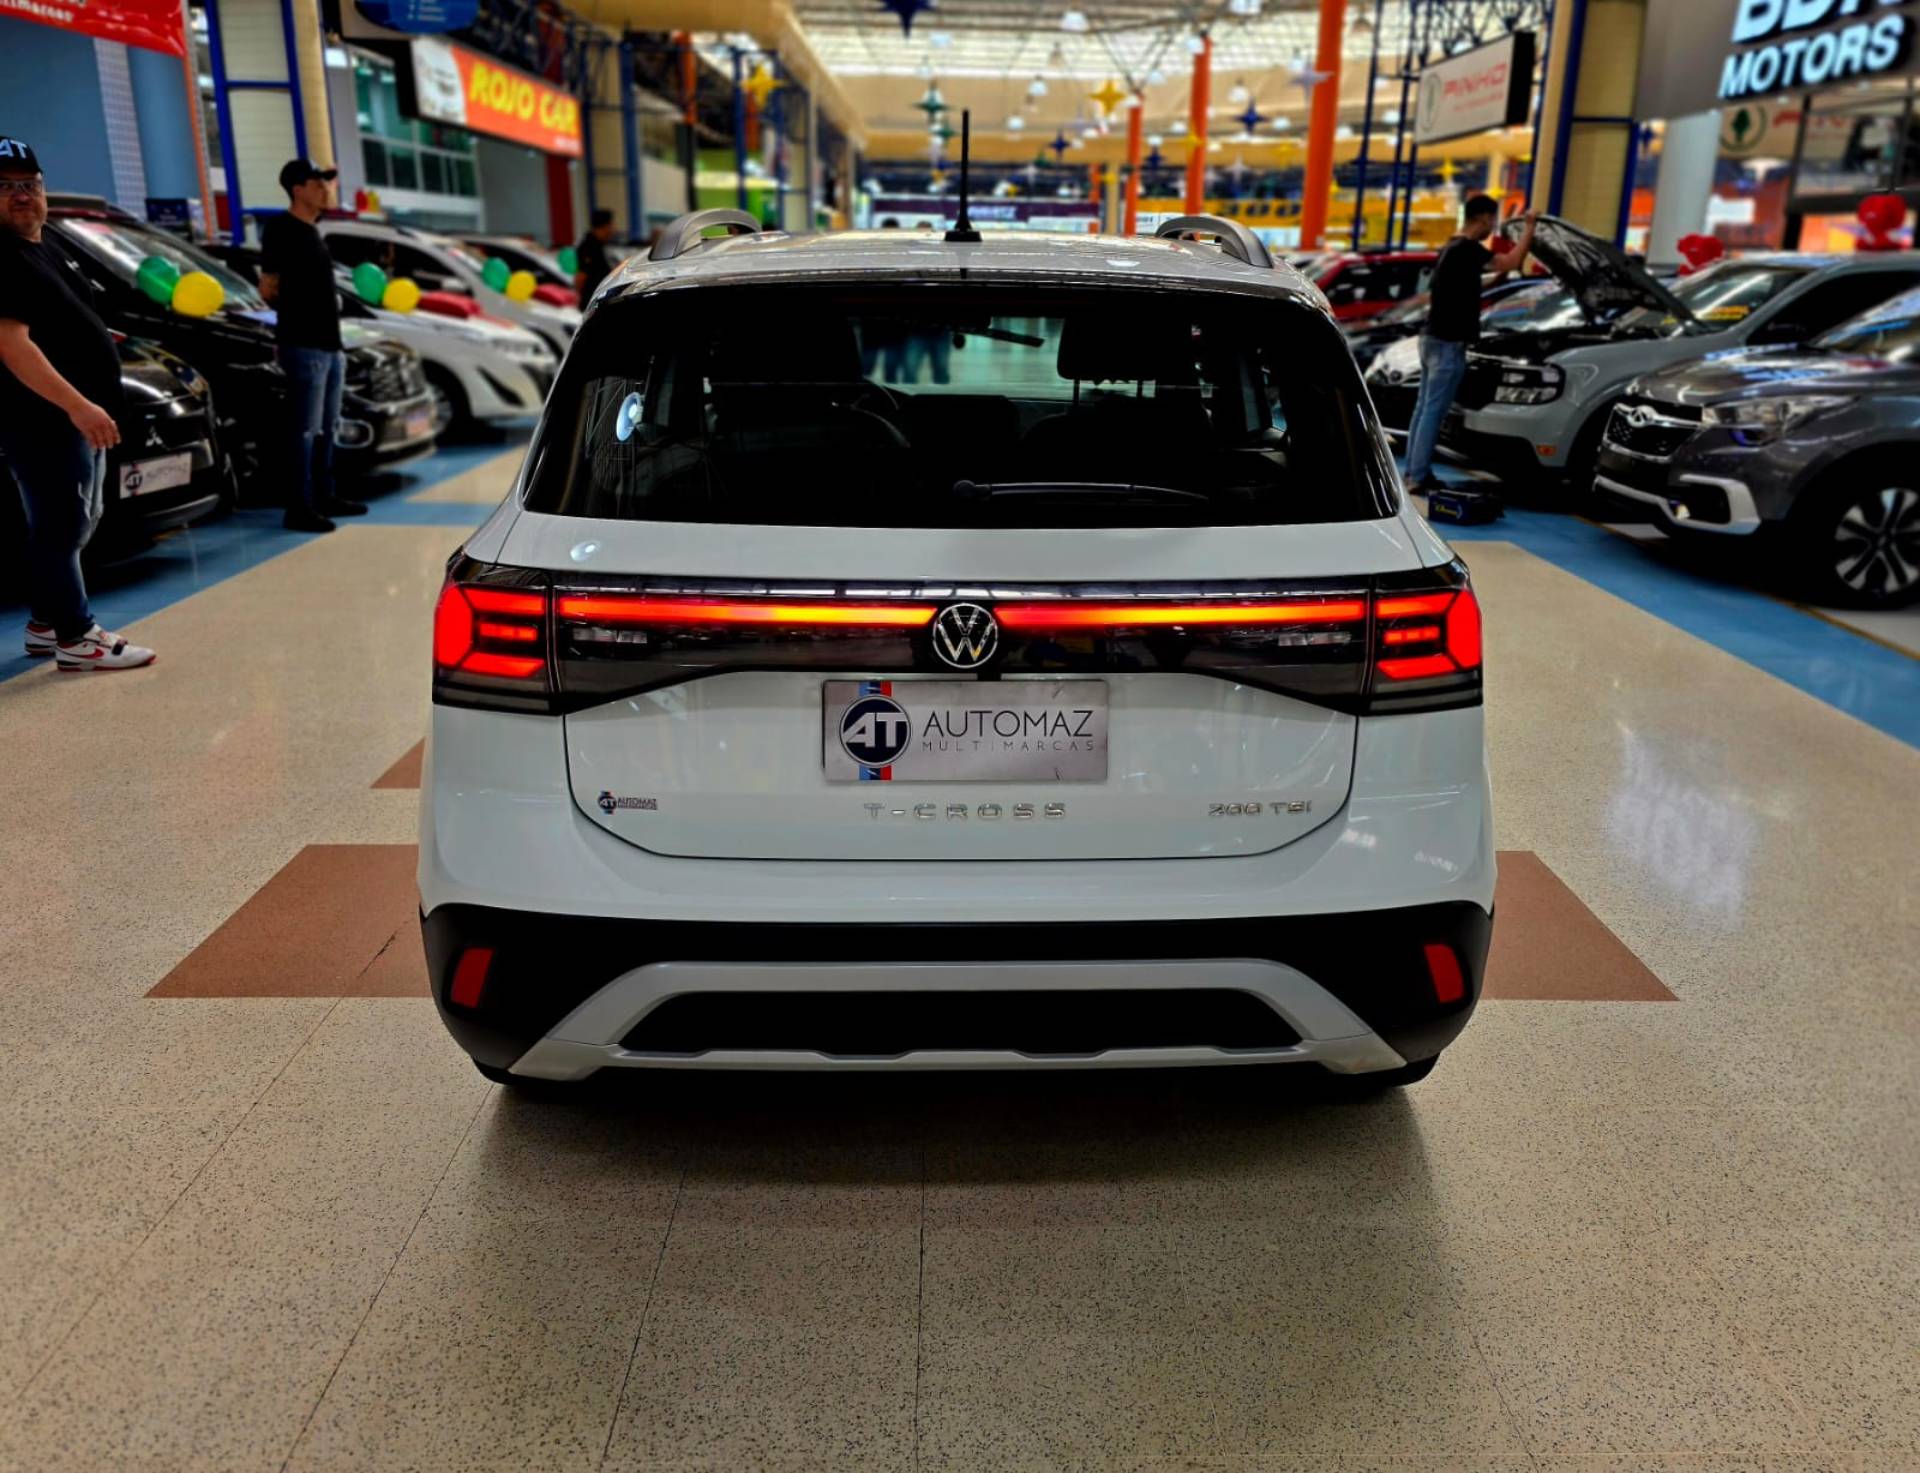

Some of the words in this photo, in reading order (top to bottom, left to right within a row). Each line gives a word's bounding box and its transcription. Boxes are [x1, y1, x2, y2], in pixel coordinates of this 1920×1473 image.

[1718, 13, 1905, 99] MOTORS
[469, 61, 536, 121] ROJO
[539, 91, 578, 137] CAR
[842, 712, 907, 748] AT
[923, 710, 1094, 738] AUTOMAZ
[863, 803, 1066, 819] T-CROSS
[1208, 802, 1262, 817] 200
